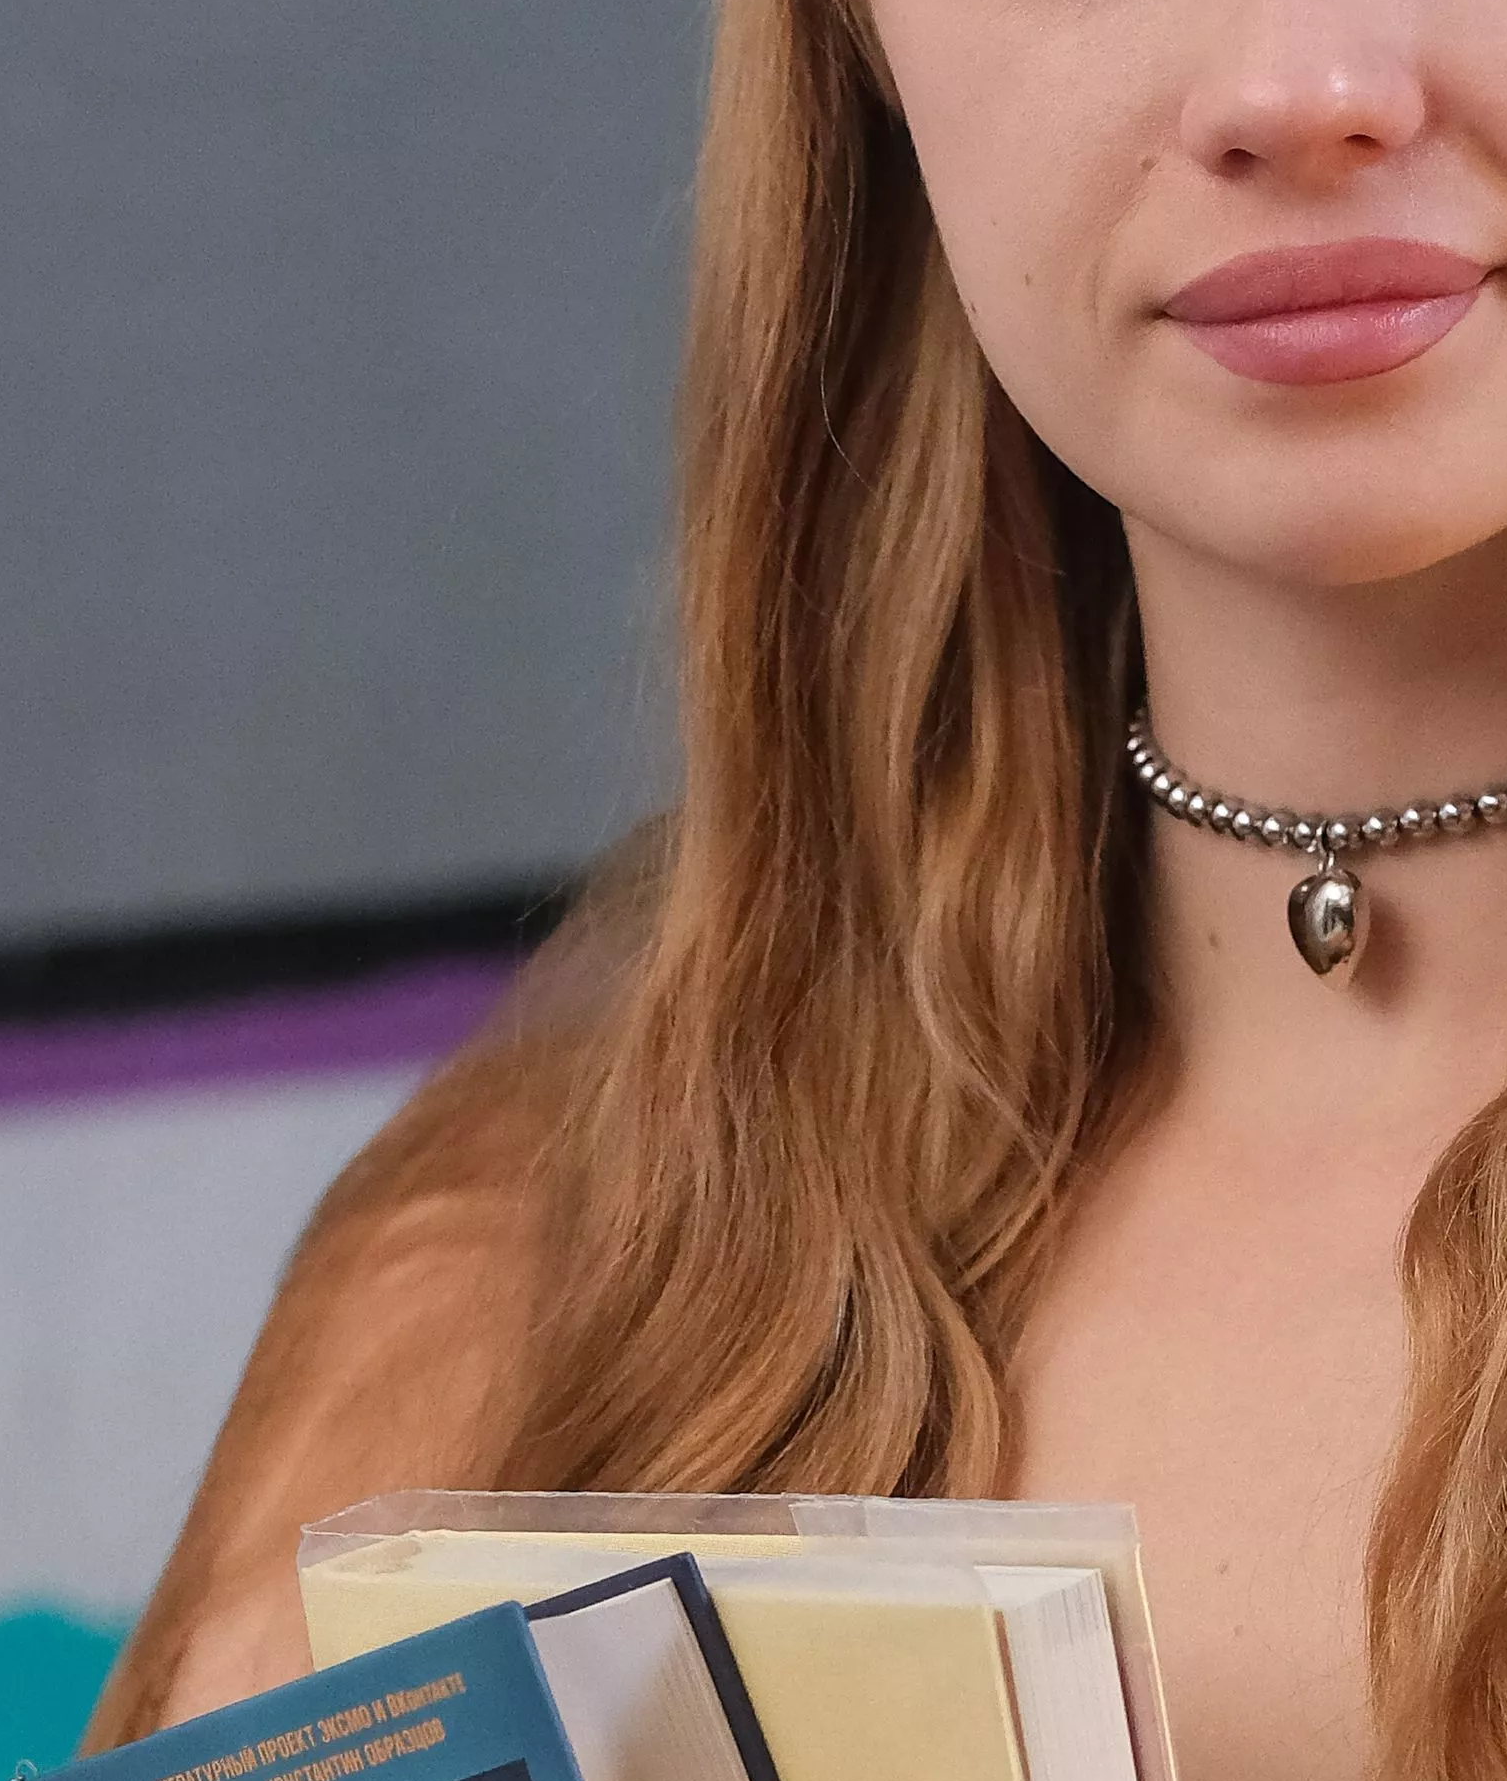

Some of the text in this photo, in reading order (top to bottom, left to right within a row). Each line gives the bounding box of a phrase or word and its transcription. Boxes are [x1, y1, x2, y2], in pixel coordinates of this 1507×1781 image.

[257, 1724, 316, 1764] ПРОЕКТ
[317, 1705, 372, 1743] ЭКСМО
[371, 1699, 388, 1724] И
[364, 1717, 446, 1766] ОБРАЗЦОВ
